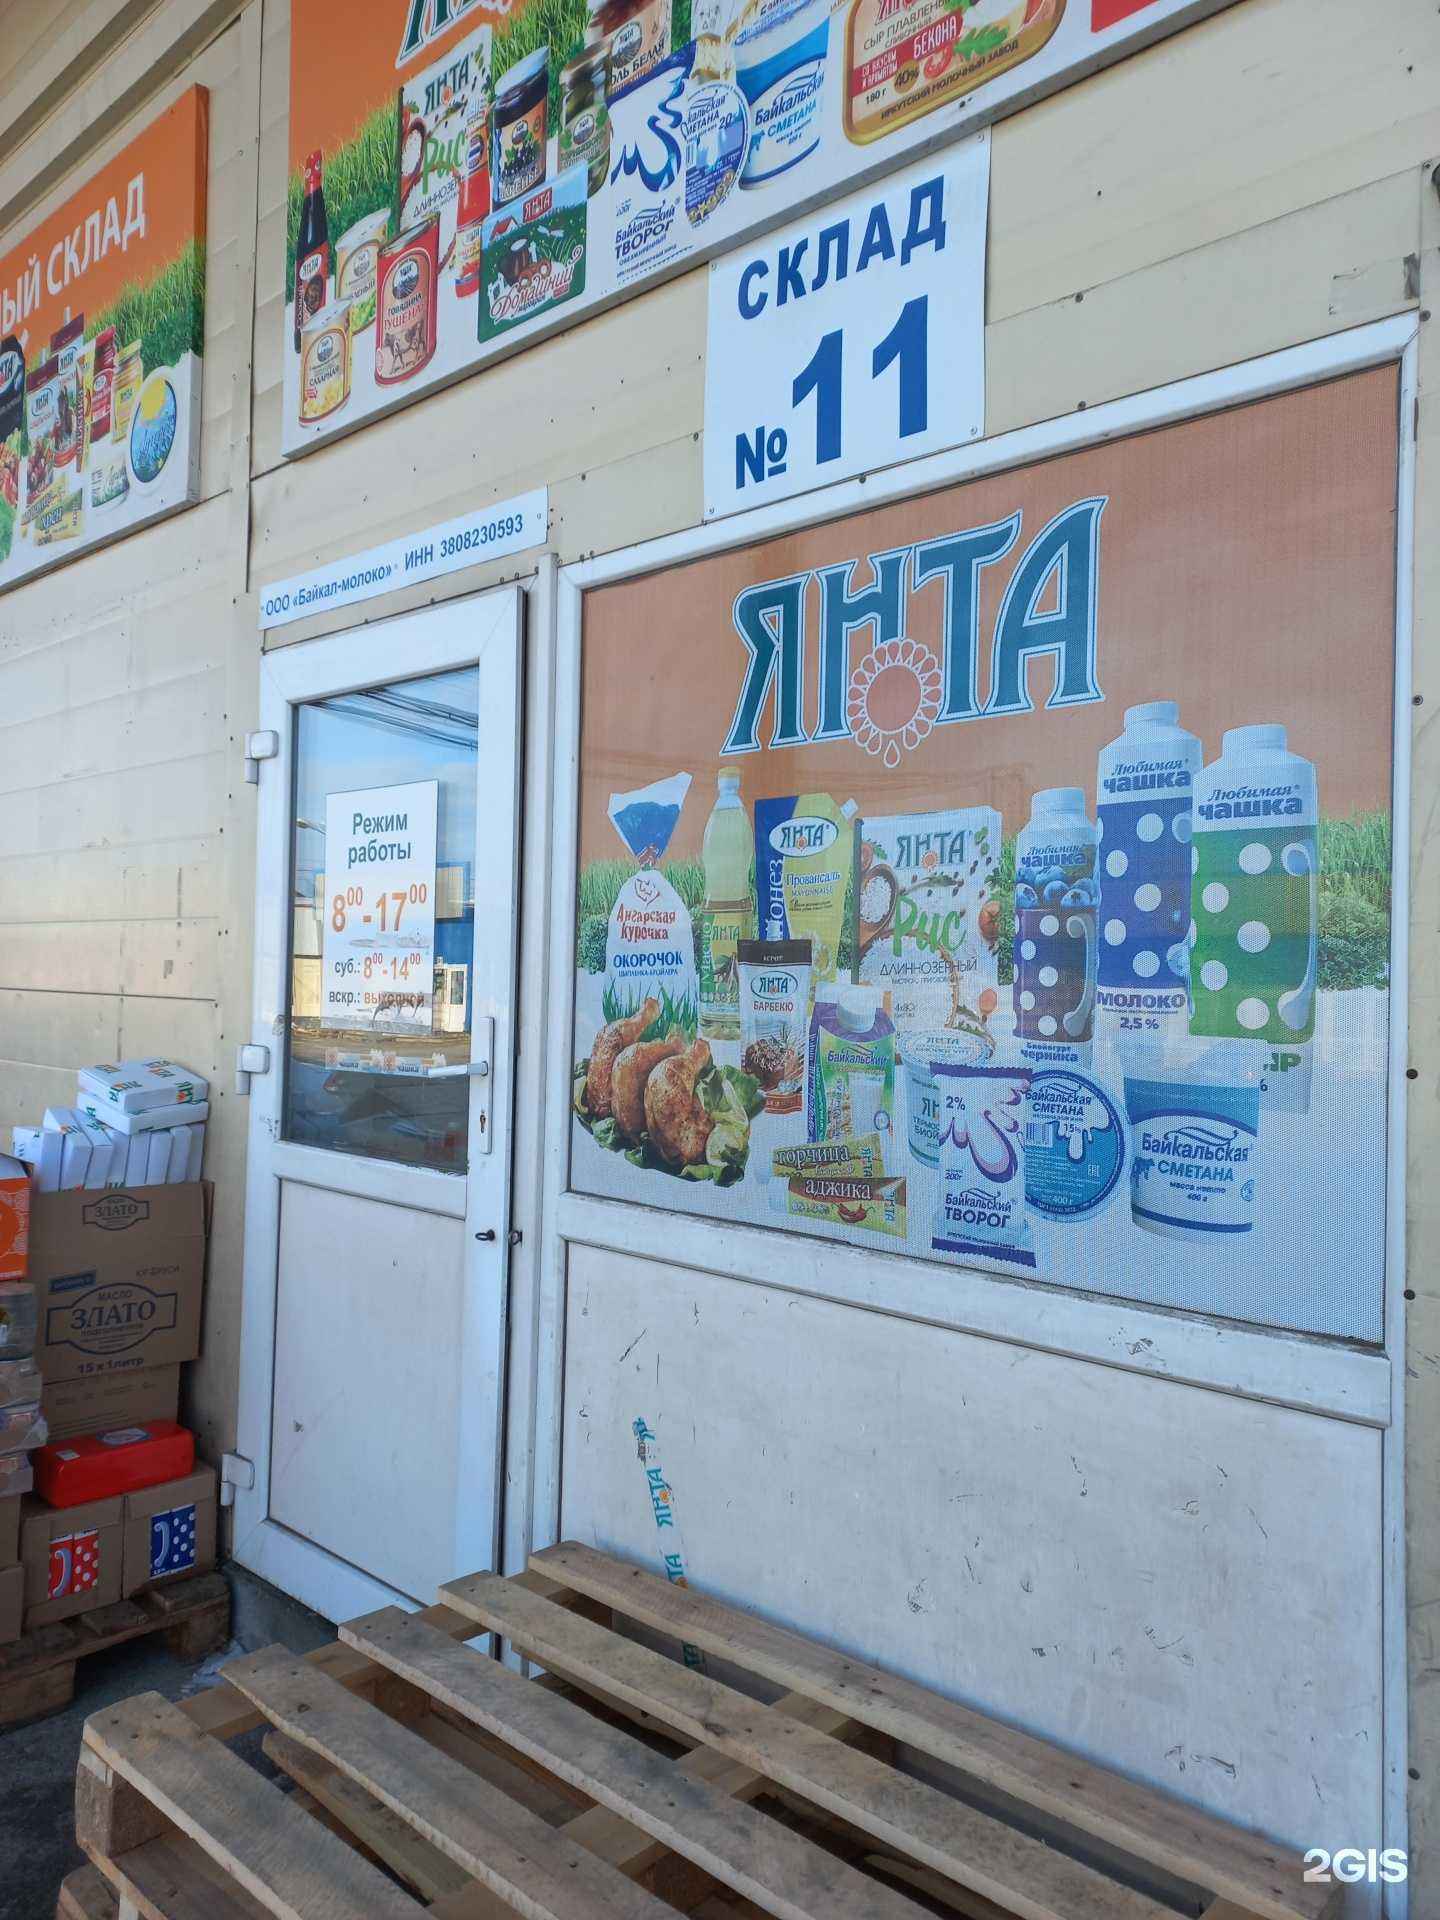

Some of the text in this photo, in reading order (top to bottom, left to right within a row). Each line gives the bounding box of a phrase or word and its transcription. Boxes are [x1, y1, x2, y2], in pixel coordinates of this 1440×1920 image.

[864, 31, 884, 50] СЫР
[913, 15, 957, 59] БЕКОНА
[424, 54, 469, 116] ЯНТА
[767, 99, 816, 137] СМЕТАНА
[525, 189, 551, 221] ЯНТА
[46, 171, 147, 296] СКЛАД
[615, 219, 674, 259] ТВОРОГ
[737, 174, 947, 321] СКЛАД
[735, 294, 928, 490] № 11
[265, 514, 524, 617] ООО «Байкал-молоко» ИНН 3808230593
[720, 495, 1109, 756] ЯНТА
[1112, 759, 1184, 777] Любимая
[1103, 770, 1192, 794] чашка
[1208, 784, 1293, 802] Любимая
[1198, 794, 1304, 821] чашка
[352, 812, 409, 836] Режим
[781, 823, 825, 849] ЯНТА
[348, 840, 412, 870] работы
[896, 829, 965, 868] ЯНТА
[713, 925, 740, 941] ЯНТА
[334, 957, 361, 979] суб.:
[612, 951, 684, 968] ОКОРОЧОК
[880, 958, 978, 976] ДЛИННОЗЕРНЫЙ
[758, 976, 789, 994] ЯНТА
[752, 1000, 795, 1013] БАРБЕКЮ
[1097, 990, 1186, 1009] МОЛОКО
[945, 1095, 966, 1111] 2%
[1032, 1102, 1085, 1117] СМЕТАНА
[1142, 1130, 1251, 1162] Байкальская
[1157, 1159, 1234, 1182] СМЕТАНА
[805, 1178, 873, 1200] аджика
[95, 1203, 139, 1218] ЗЛАТО
[944, 1190, 1013, 1213] Байкальский
[944, 1206, 1011, 1229] ТВОРОГ
[98, 1289, 134, 1302] МАСЛО
[70, 1300, 156, 1330] ЗЛАТО
[79, 1363, 97, 1374] 15
[646, 1467, 673, 1527] ЯНТА
